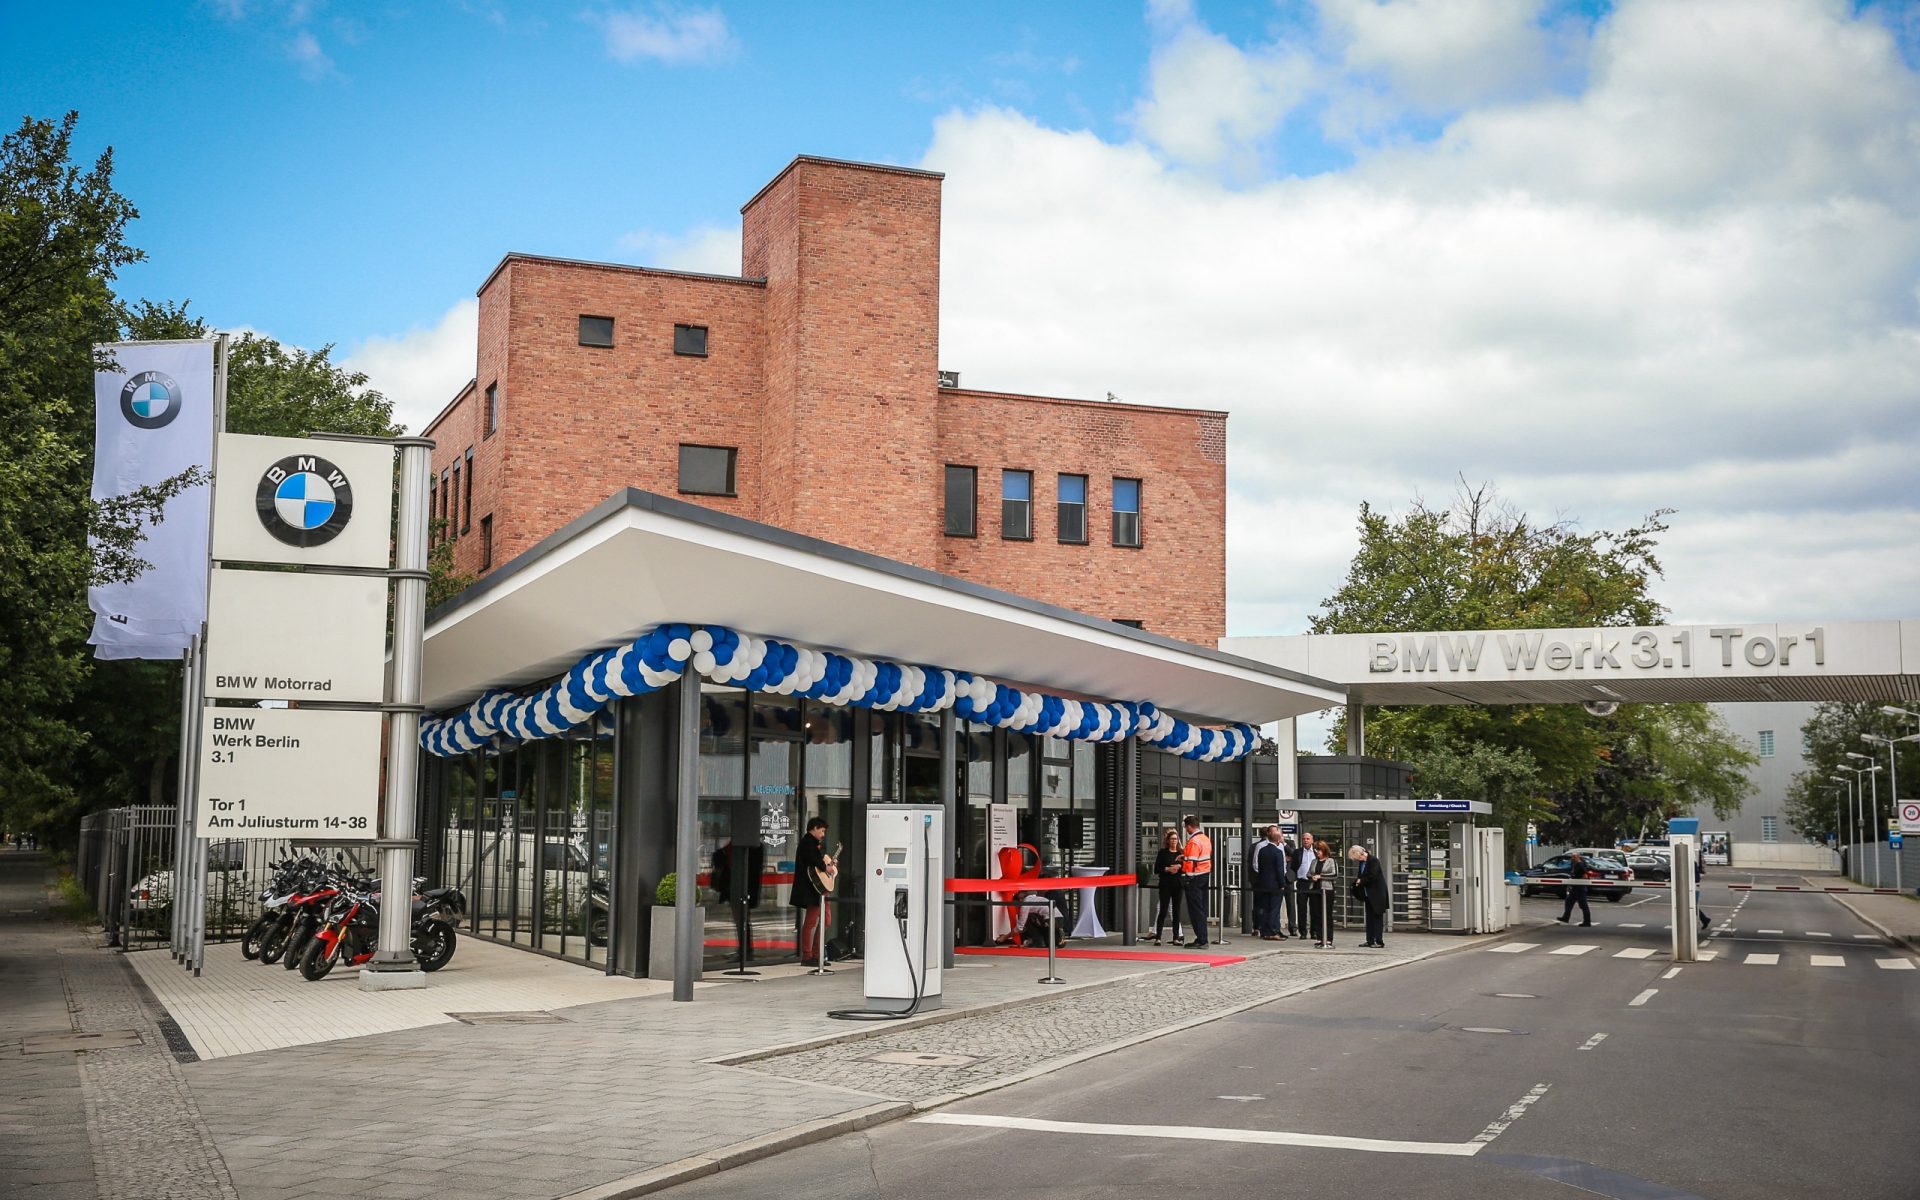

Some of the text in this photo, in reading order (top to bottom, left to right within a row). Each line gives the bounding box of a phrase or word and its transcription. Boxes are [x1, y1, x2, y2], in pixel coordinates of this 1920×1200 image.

[266, 457, 348, 488] BMW
[1369, 627, 1825, 673] BMW Werk 3.1 Tor 1
[216, 676, 332, 691] BMW Motorrad
[213, 718, 256, 730] BMW
[213, 734, 300, 748] Werk Berlin
[211, 751, 234, 763] 3.1
[209, 799, 246, 811] Tor 1
[208, 815, 368, 829] Am Juliusturm 14-38
